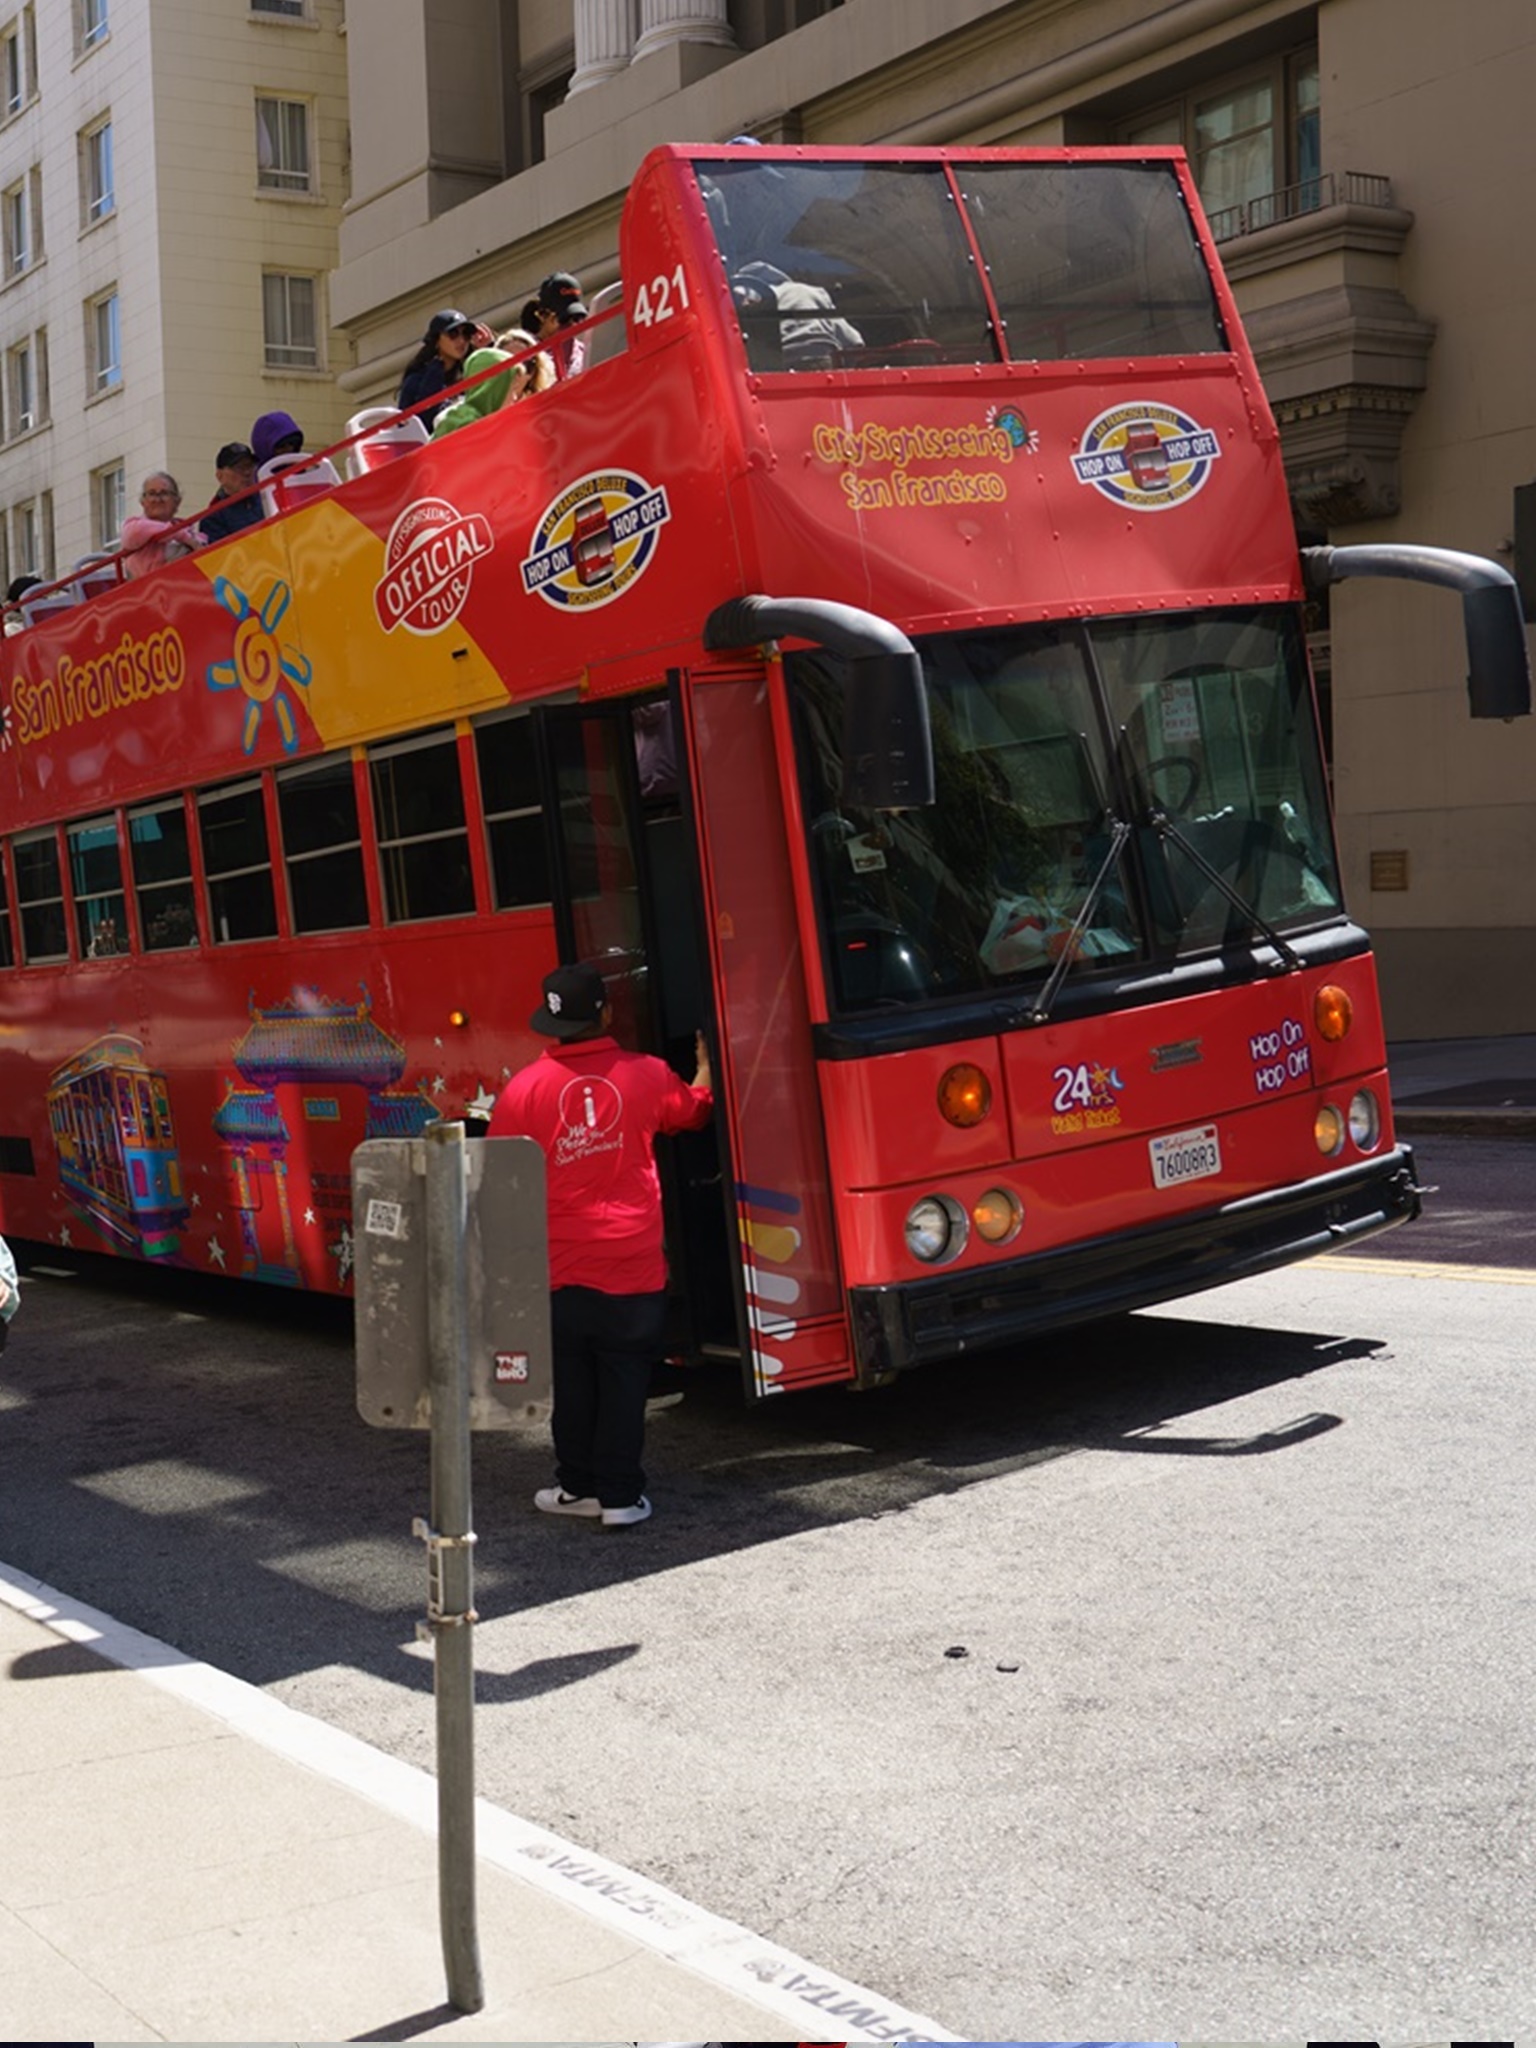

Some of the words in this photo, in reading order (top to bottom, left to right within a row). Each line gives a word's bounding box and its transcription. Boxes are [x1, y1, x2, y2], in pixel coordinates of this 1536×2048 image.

[633, 264, 689, 328] 421
[1078, 459, 1104, 477] HOP
[1105, 453, 1125, 472] ON
[1166, 440, 1191, 461] HOP
[1192, 436, 1214, 454] OFF
[840, 471, 893, 511] San
[891, 469, 1007, 508] Francisco
[612, 510, 639, 539] HOP
[640, 496, 663, 524] OFF
[385, 522, 487, 616] OFFICIAL
[526, 558, 551, 585] HOP
[550, 546, 571, 572] ON
[420, 577, 466, 624] TOUR
[12, 675, 60, 744] San
[58, 626, 185, 726] Francisco
[1250, 1031, 1280, 1060] Hop
[1282, 1020, 1303, 1046] On
[1053, 1064, 1092, 1112] 24
[1256, 1064, 1286, 1092] Hop
[1287, 1047, 1309, 1077] Off
[1156, 1144, 1217, 1180] 76008R3
